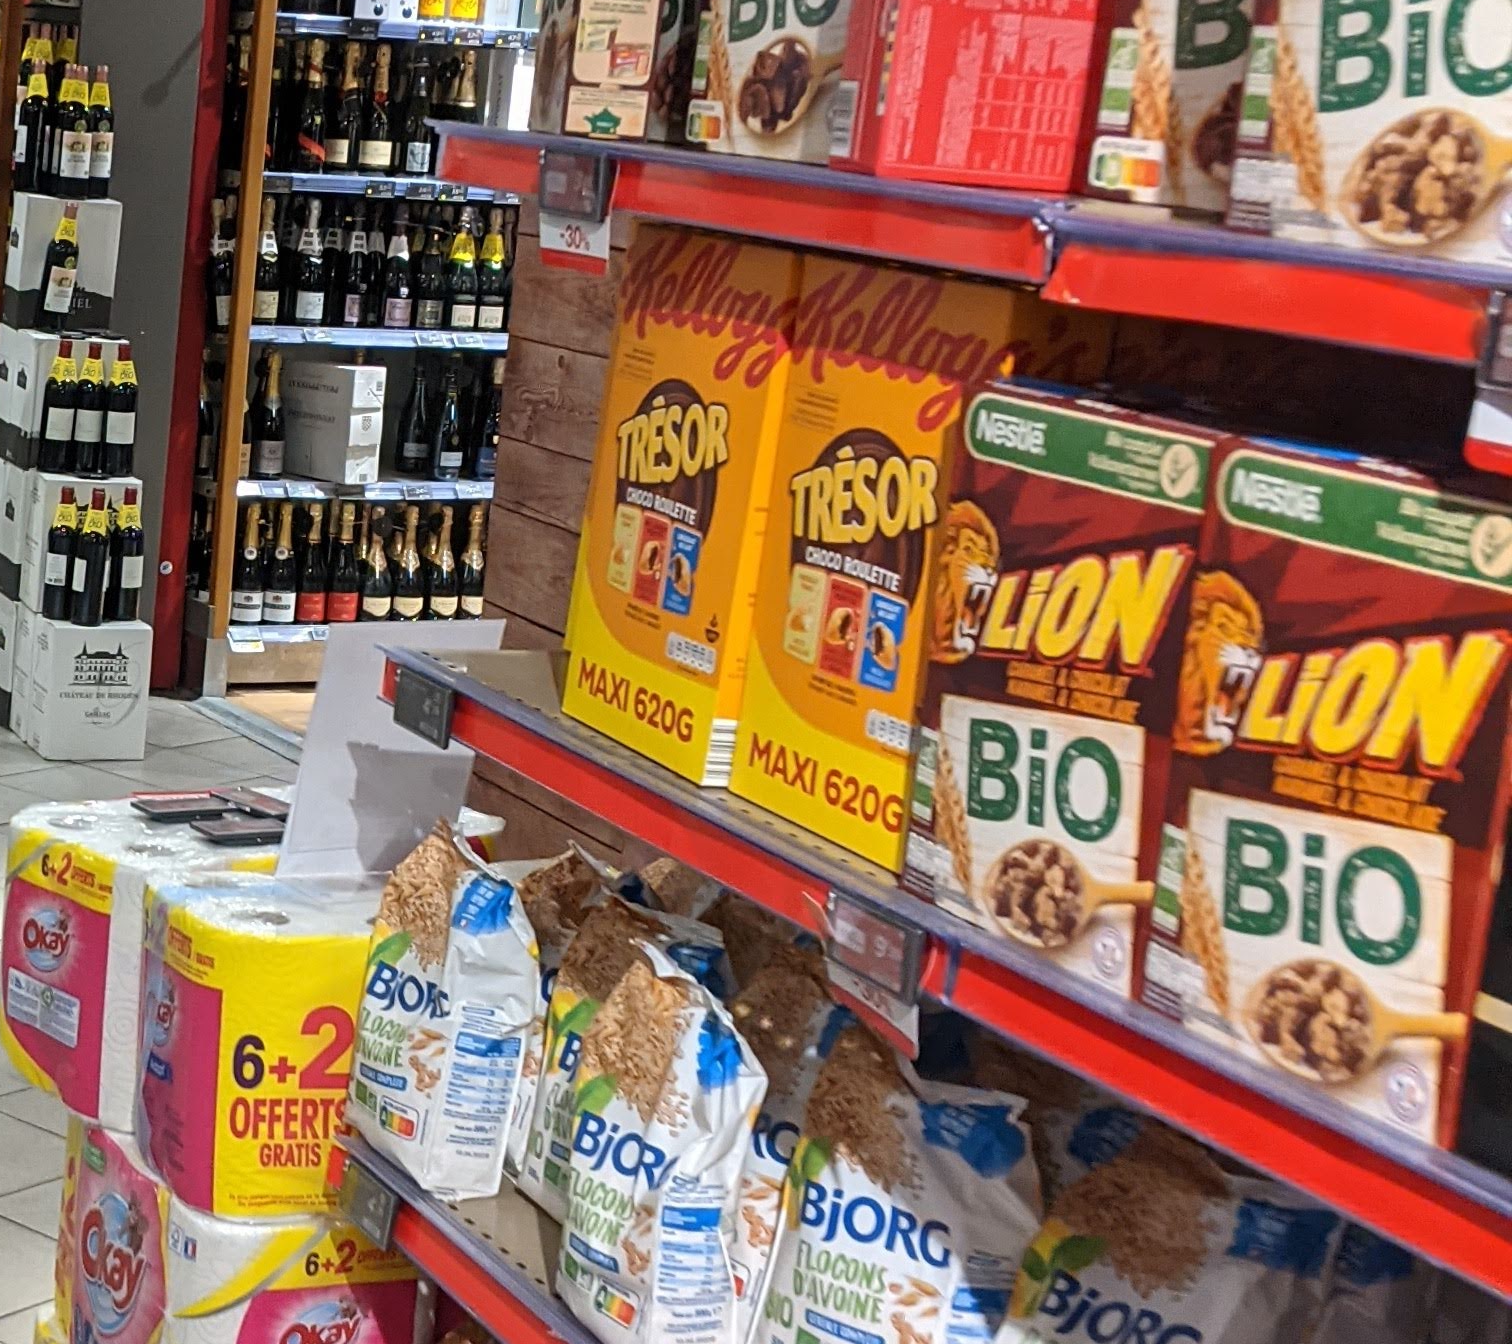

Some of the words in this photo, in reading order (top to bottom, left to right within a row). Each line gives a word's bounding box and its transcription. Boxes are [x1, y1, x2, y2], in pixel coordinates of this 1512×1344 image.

[618, 396, 728, 484] TRÉSOR
[792, 445, 937, 544] TRÉSOR
[805, 546, 842, 571] CHOCO
[844, 556, 901, 591] ROULETTE
[578, 660, 630, 714] MAXI
[634, 687, 694, 743] 620G
[748, 732, 818, 797] MAXI
[824, 768, 904, 833] 620G
[23, 918, 70, 957] Okay
[230, 1098, 351, 1141] OFFERTS
[259, 1142, 321, 1168] GRATIS
[82, 1208, 145, 1313] Okay
[796, 1239, 888, 1293] FLOCONS
[793, 1268, 884, 1323] D'AVOINE
